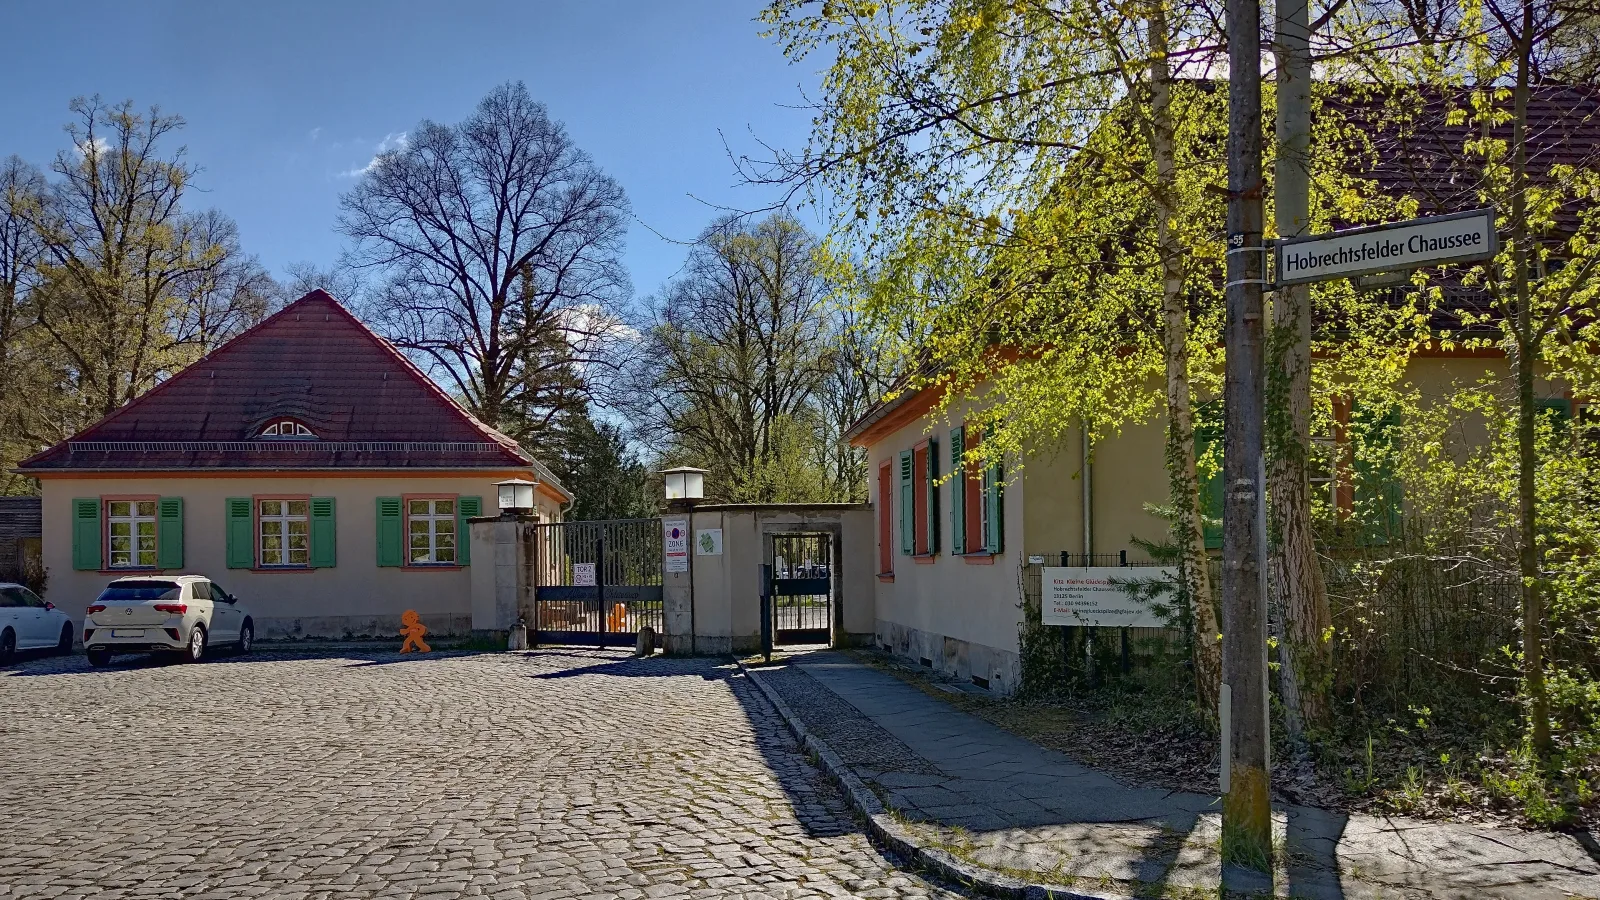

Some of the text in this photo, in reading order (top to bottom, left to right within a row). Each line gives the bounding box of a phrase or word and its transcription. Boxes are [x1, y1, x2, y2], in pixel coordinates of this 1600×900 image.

[1233, 234, 1244, 245] 55
[1286, 230, 1482, 272] Hobrechtsfelder Chaussee
[668, 540, 684, 548] ZONE
